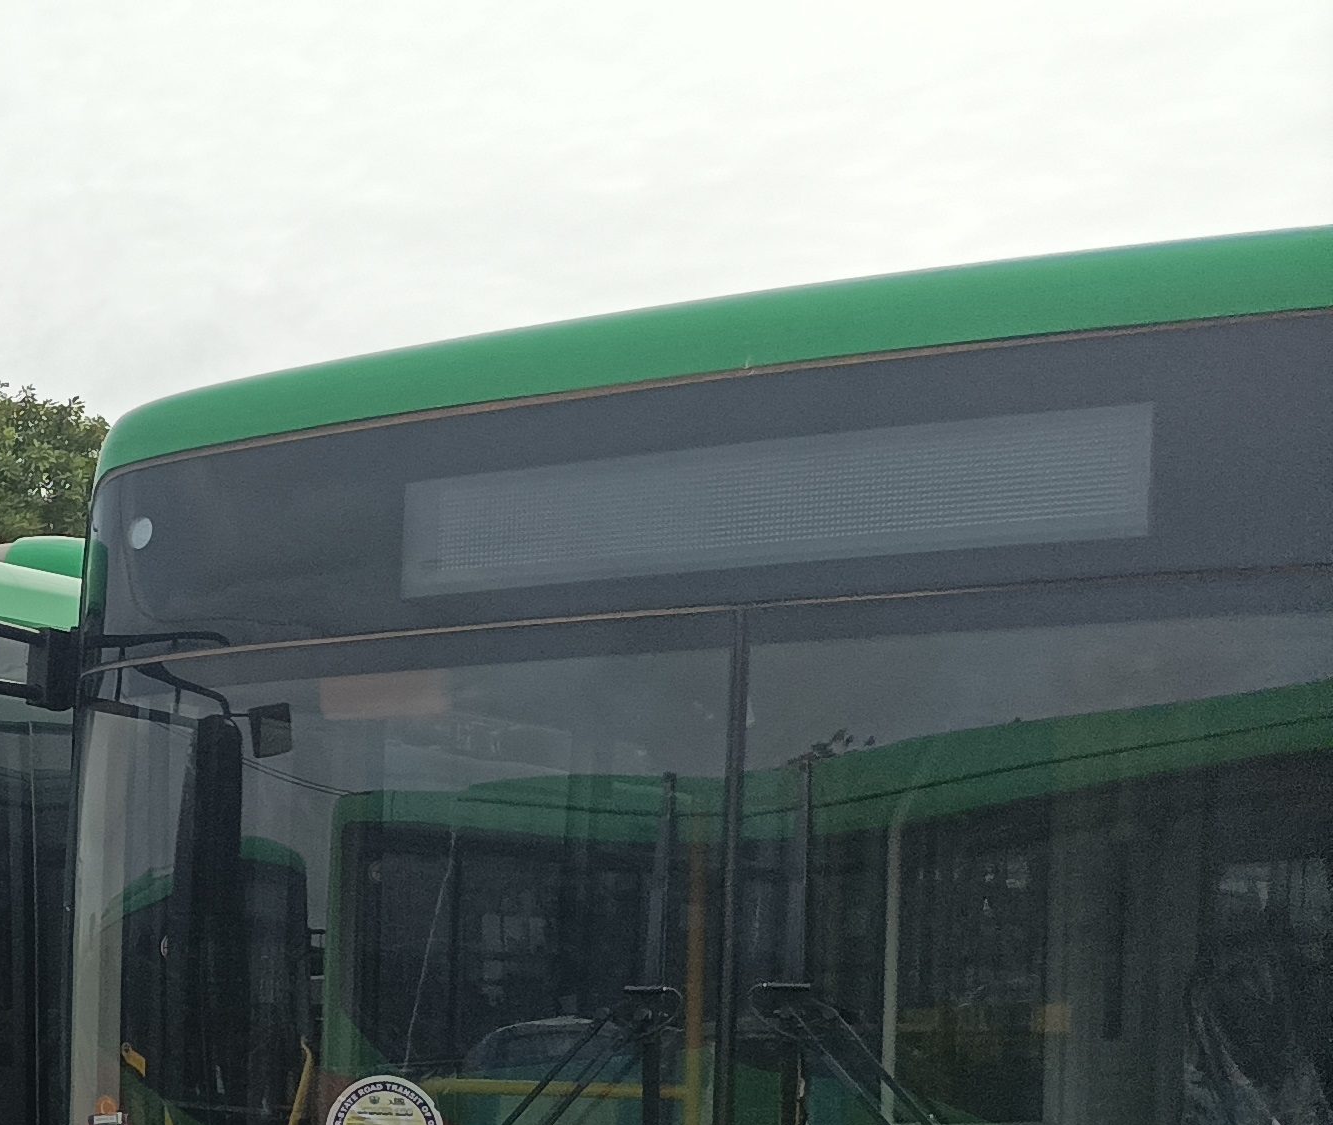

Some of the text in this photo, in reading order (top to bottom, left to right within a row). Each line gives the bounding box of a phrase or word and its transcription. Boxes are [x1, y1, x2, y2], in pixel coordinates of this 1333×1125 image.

[358, 1084, 383, 1096] ROAD
[385, 1084, 421, 1108] TRANSIT
[422, 1105, 433, 1119] OF
